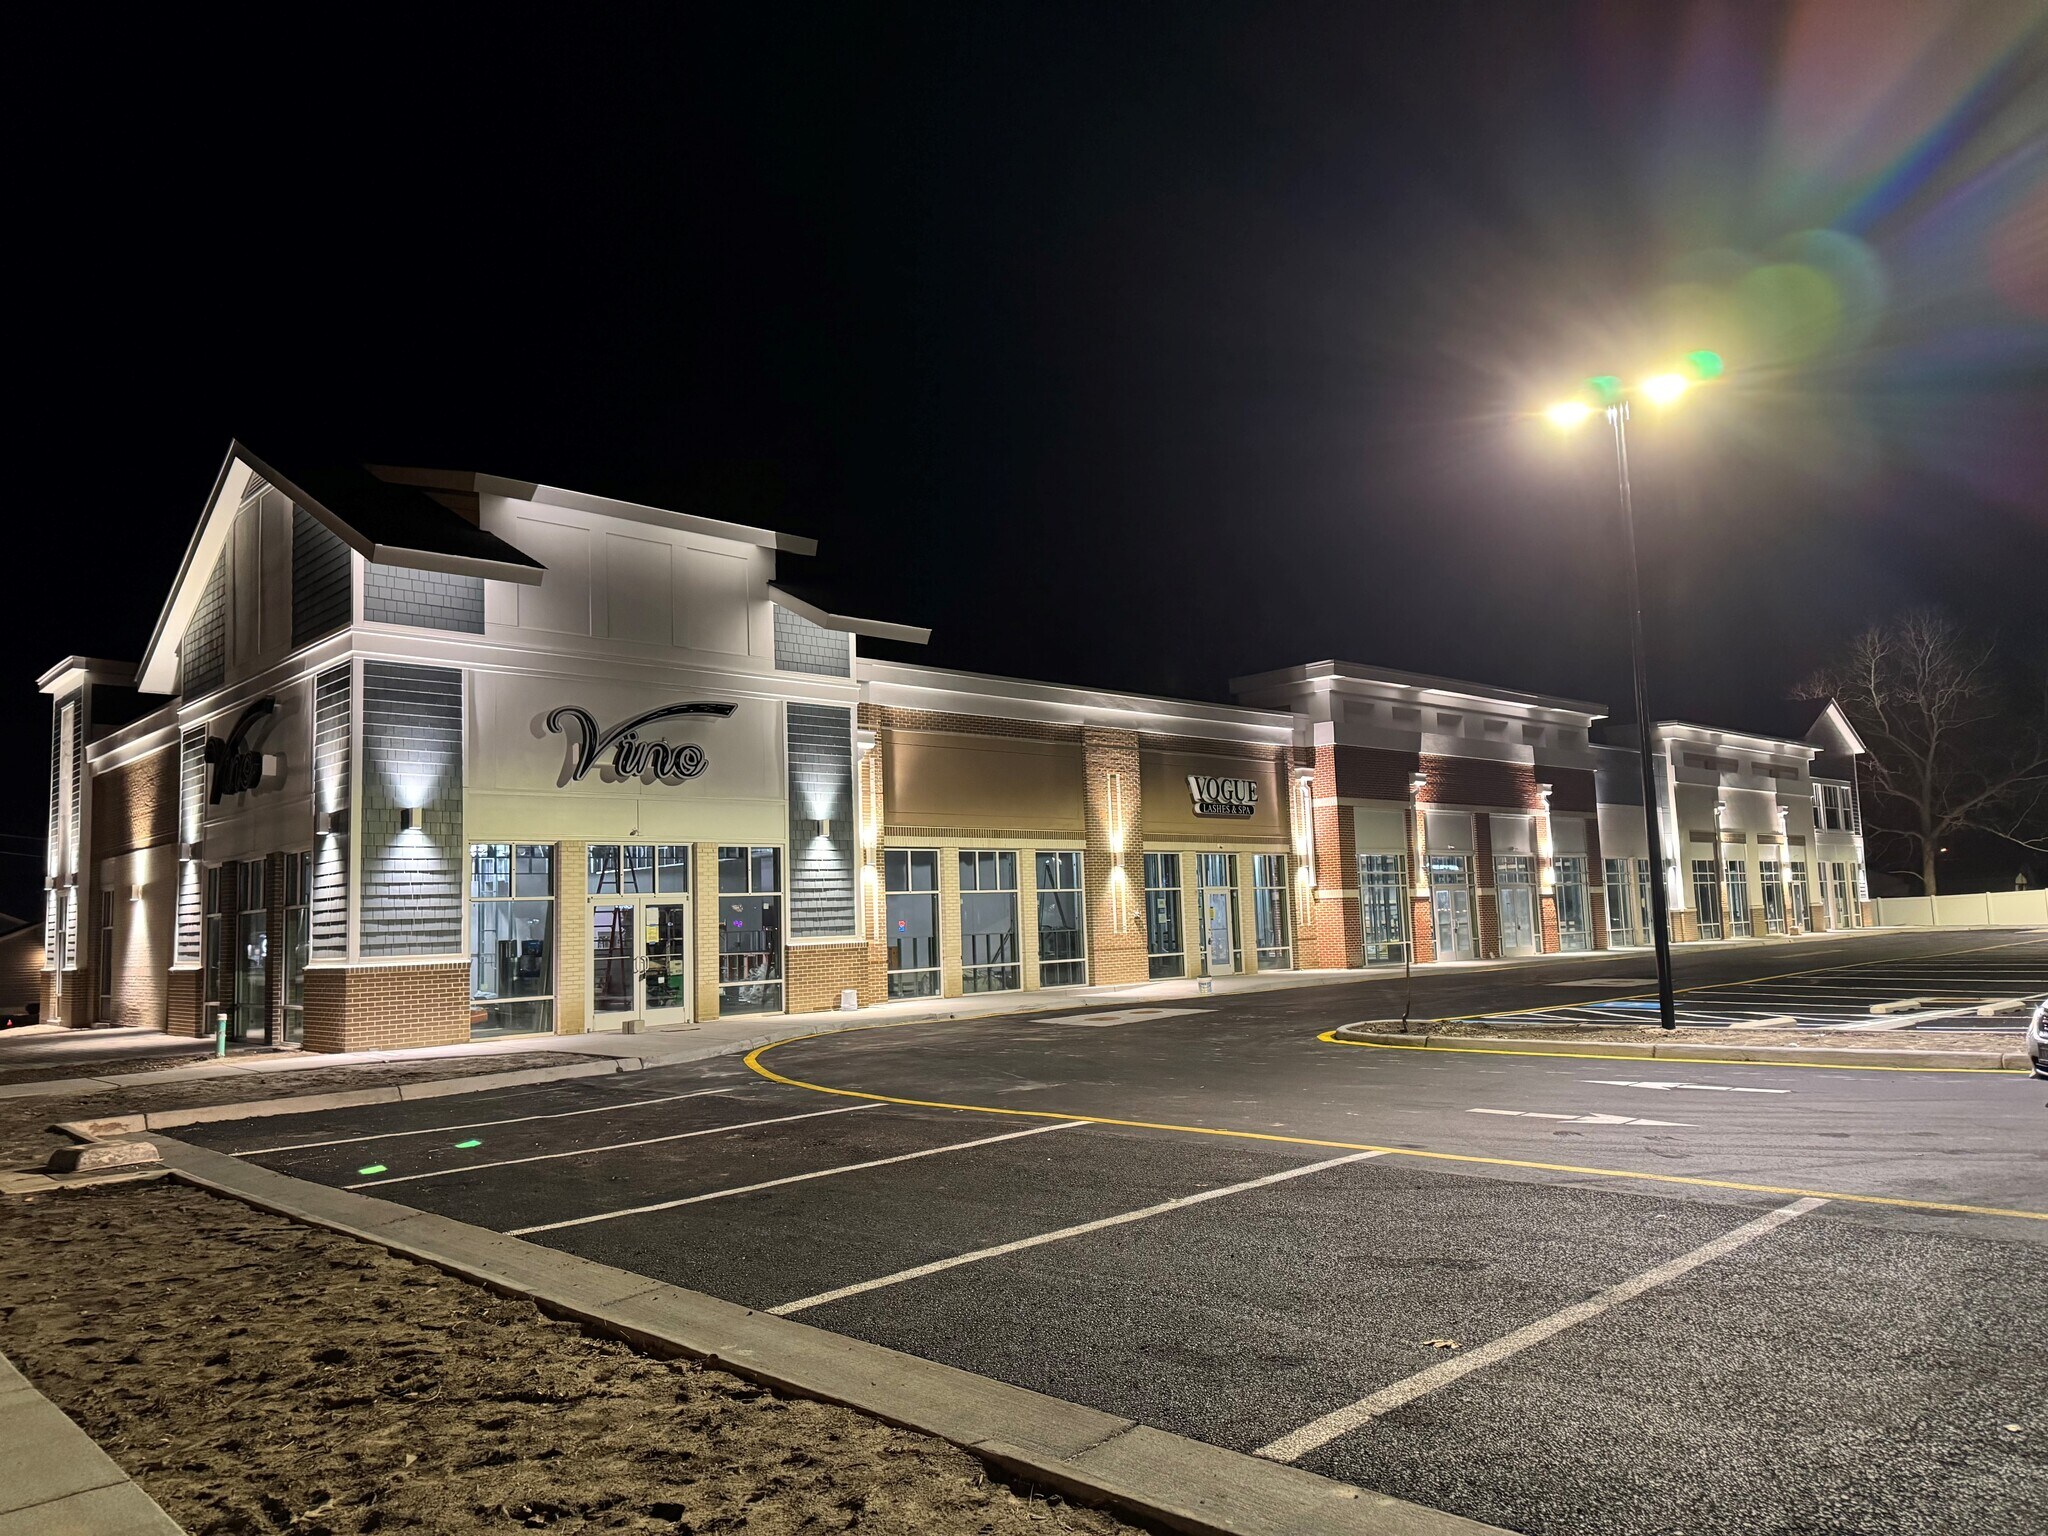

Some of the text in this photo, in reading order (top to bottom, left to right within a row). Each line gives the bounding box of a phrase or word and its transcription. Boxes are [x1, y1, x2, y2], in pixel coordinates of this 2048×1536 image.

[546, 701, 738, 780] Vino
[1191, 775, 1259, 803] VOGUE
[1203, 803, 1251, 815] LASHES & SPA
